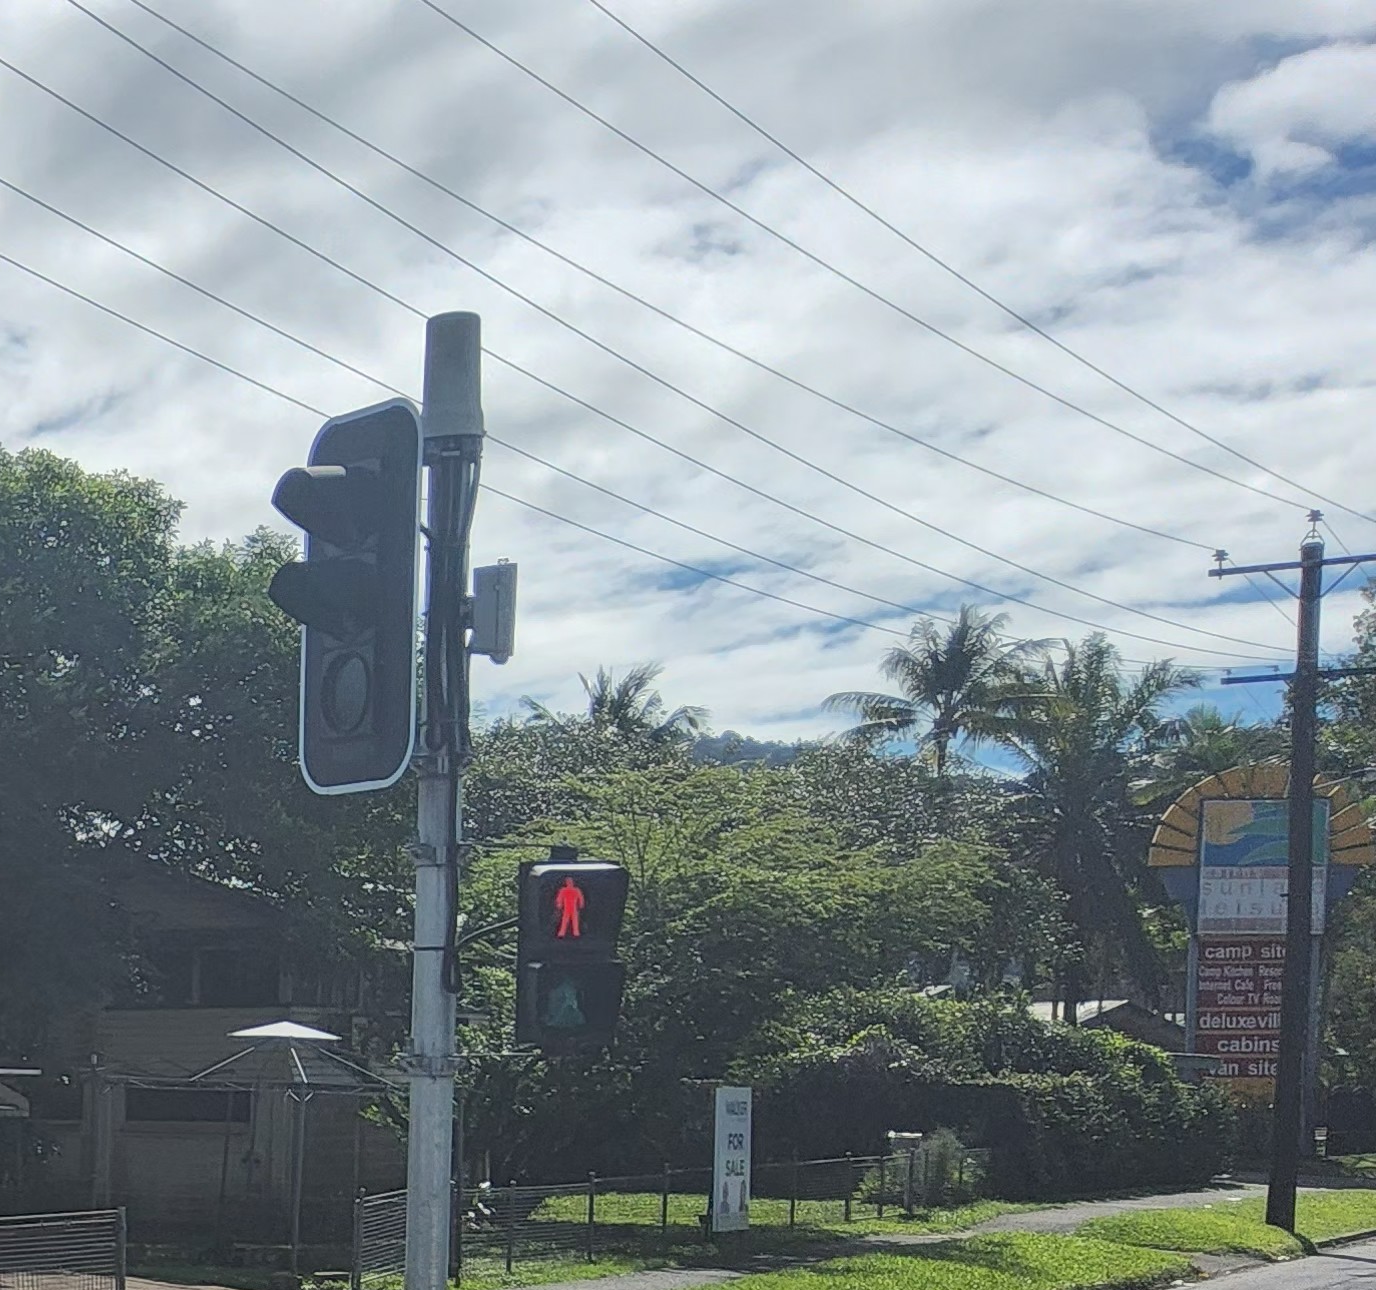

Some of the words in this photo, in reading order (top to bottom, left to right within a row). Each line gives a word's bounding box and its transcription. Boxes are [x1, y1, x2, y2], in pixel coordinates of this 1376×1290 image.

[1205, 945, 1252, 959] camp
[1199, 1012, 1281, 1029] deluxevill
[1217, 1036, 1280, 1052] cabins
[727, 1133, 744, 1150] FOR
[725, 1159, 745, 1177] SALE
